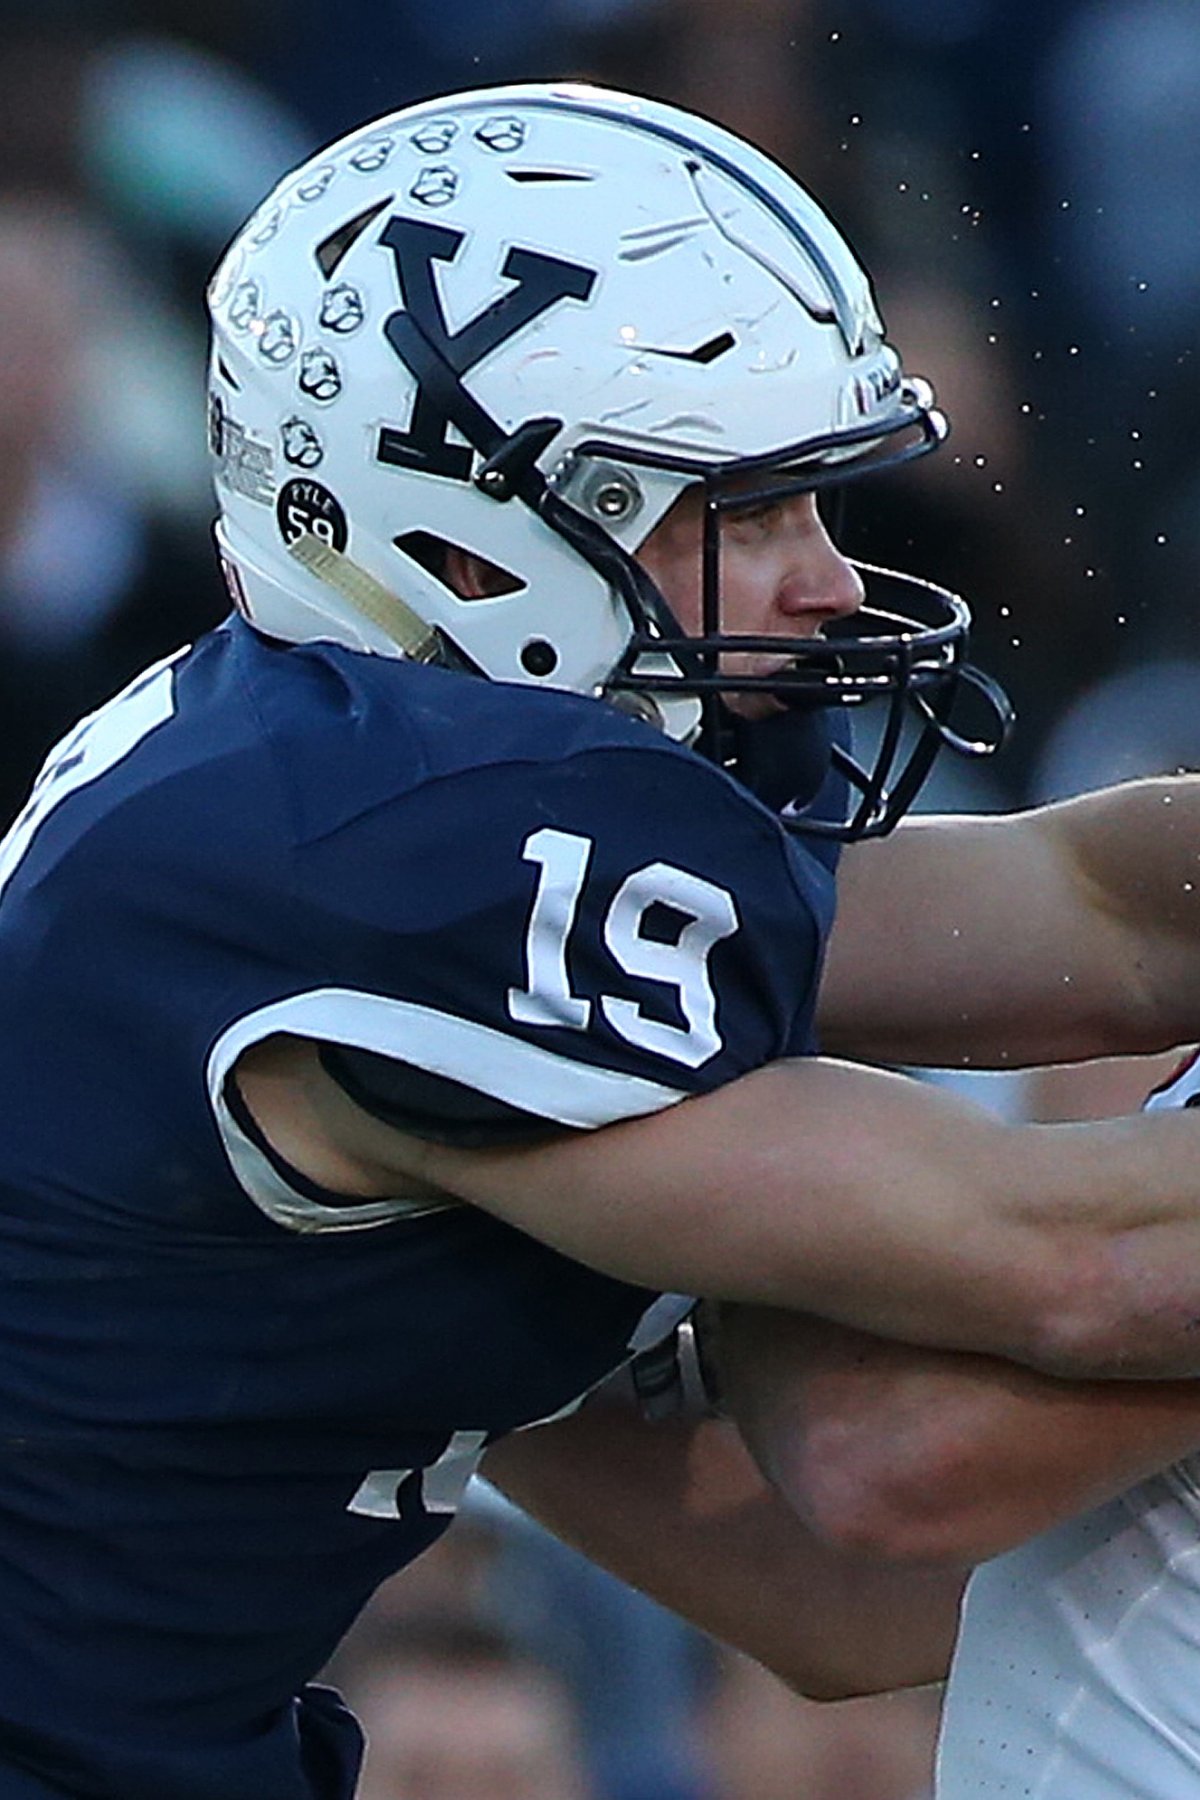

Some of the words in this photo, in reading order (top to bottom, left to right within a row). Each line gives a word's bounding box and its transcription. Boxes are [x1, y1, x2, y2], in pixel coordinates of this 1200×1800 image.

[378, 215, 597, 481] Y
[287, 505, 334, 549] 59
[508, 828, 739, 1068] 19
